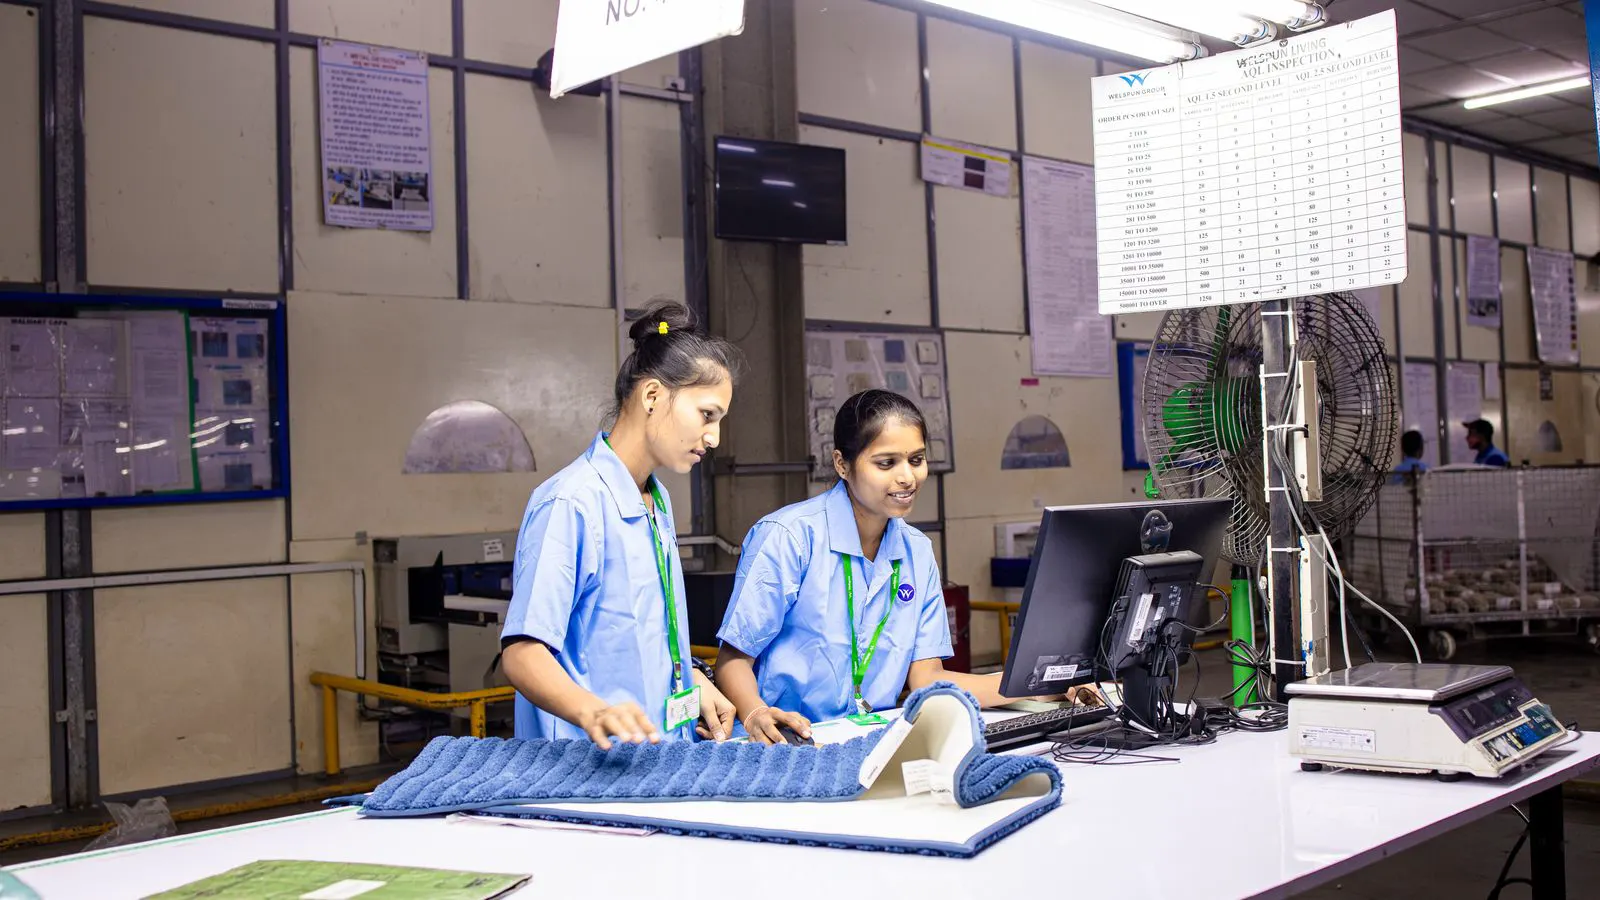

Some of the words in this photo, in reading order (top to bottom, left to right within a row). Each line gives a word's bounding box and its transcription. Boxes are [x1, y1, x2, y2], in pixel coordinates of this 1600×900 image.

[1291, 38, 1326, 54] LIVING
[1241, 66, 1264, 79] AQL
[1267, 48, 1335, 72] INSPECTION
[1296, 71, 1312, 81] AQL
[1326, 58, 1361, 74] SECOND
[1363, 49, 1392, 64] LEVEL
[1108, 90, 1140, 100] WELSPUN
[1187, 94, 1204, 104] AQL
[1218, 84, 1252, 96] SECOND
[1254, 78, 1282, 90] LEVEL
[1098, 114, 1121, 124] ORDER
